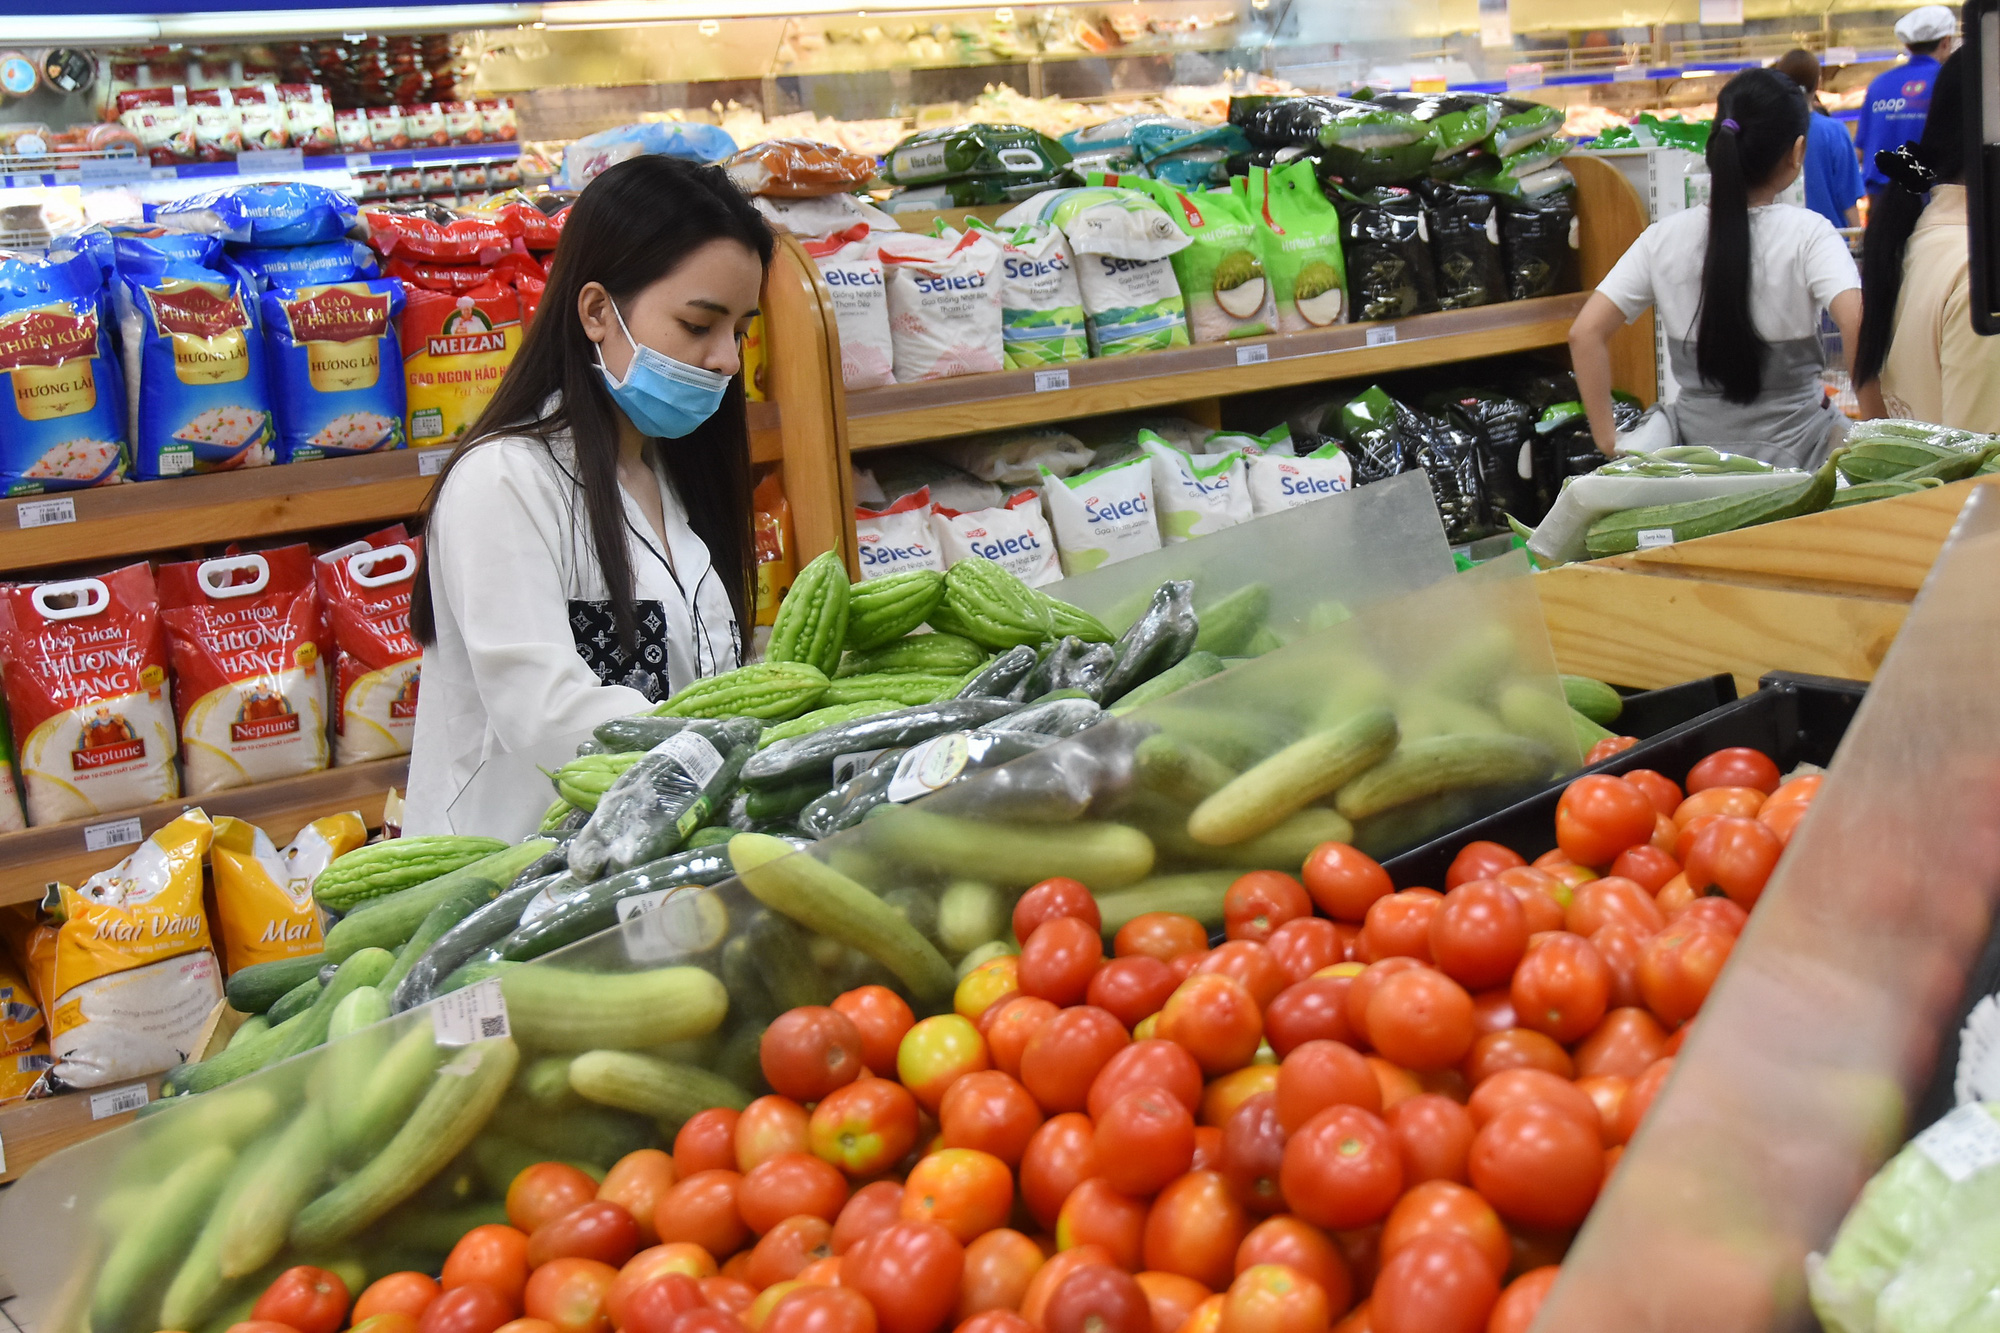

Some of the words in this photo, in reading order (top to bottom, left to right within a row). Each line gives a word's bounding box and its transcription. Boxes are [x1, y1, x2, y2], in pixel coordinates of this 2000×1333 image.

[825, 267, 882, 287] elect
[178, 351, 227, 363] HƯƠNG
[230, 345, 247, 360] LÀI
[430, 333, 505, 355] MEIZAN
[312, 357, 358, 372] HƯƠNG
[361, 354, 378, 368] LÀI
[438, 370, 472, 384] NGON
[475, 365, 497, 381] HẢO
[17, 382, 70, 399] HƯƠNG
[74, 376, 93, 392] LÀI
[1281, 475, 1347, 496] Select
[1085, 492, 1147, 523] Select
[859, 543, 931, 565] Select
[970, 529, 1040, 560] Select
[207, 612, 236, 627] GẠO
[238, 605, 278, 621] THƠM
[203, 623, 296, 653] THƯỢNG
[36, 645, 140, 677] THƯỢNG
[220, 649, 285, 674] HẠNG
[235, 719, 296, 739] Neptune
[77, 743, 141, 767] Neptune
[93, 918, 145, 941] Mai
[261, 917, 313, 943] Mai
